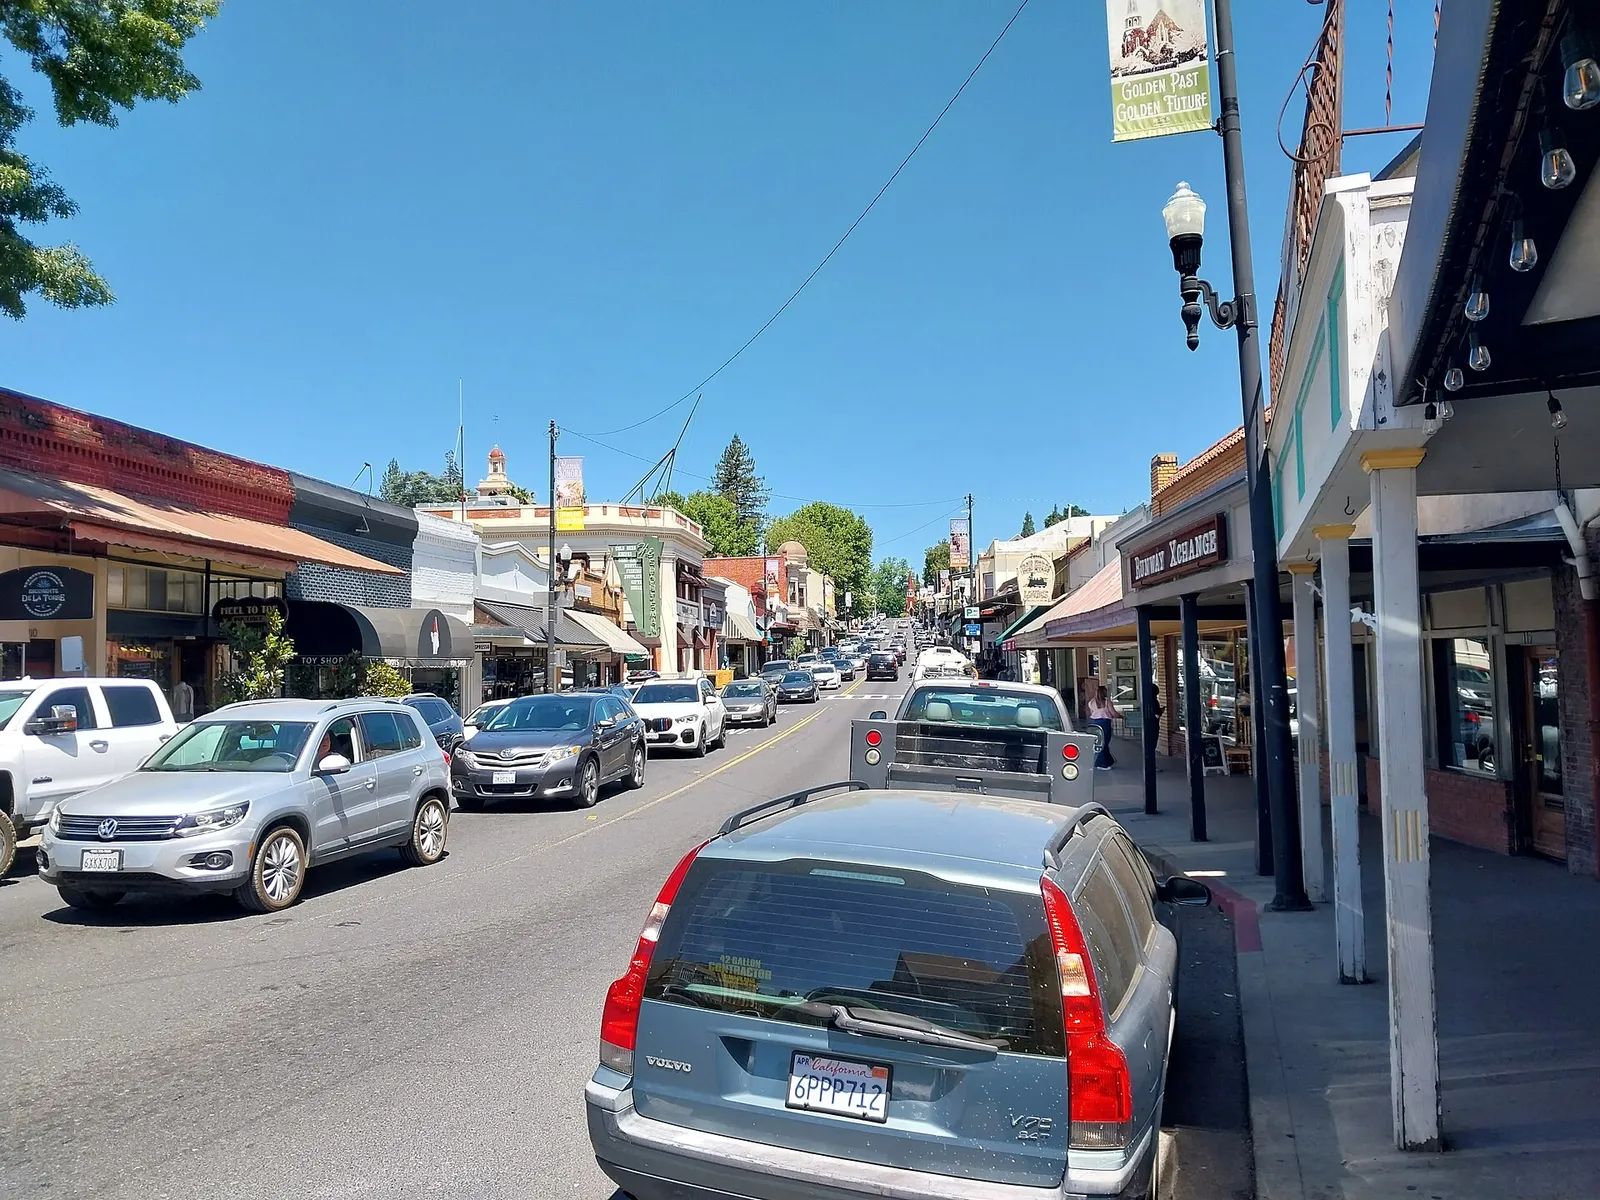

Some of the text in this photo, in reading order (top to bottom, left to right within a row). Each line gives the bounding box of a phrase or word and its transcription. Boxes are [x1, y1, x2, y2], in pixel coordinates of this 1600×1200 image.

[1121, 72, 1199, 101] GOLDEN PAST
[1116, 92, 1208, 121] GOLDEN FUTURE
[1168, 529, 1218, 567] XCHANGE
[246, 605, 259, 614] TO
[320, 657, 344, 665] SHOP
[708, 962, 772, 980] CONTRACTOR
[731, 956, 761, 969] GALLON
[645, 1055, 693, 1073] VOLVO
[796, 1056, 873, 1079] APR California
[794, 1074, 883, 1111] 6PPP712
